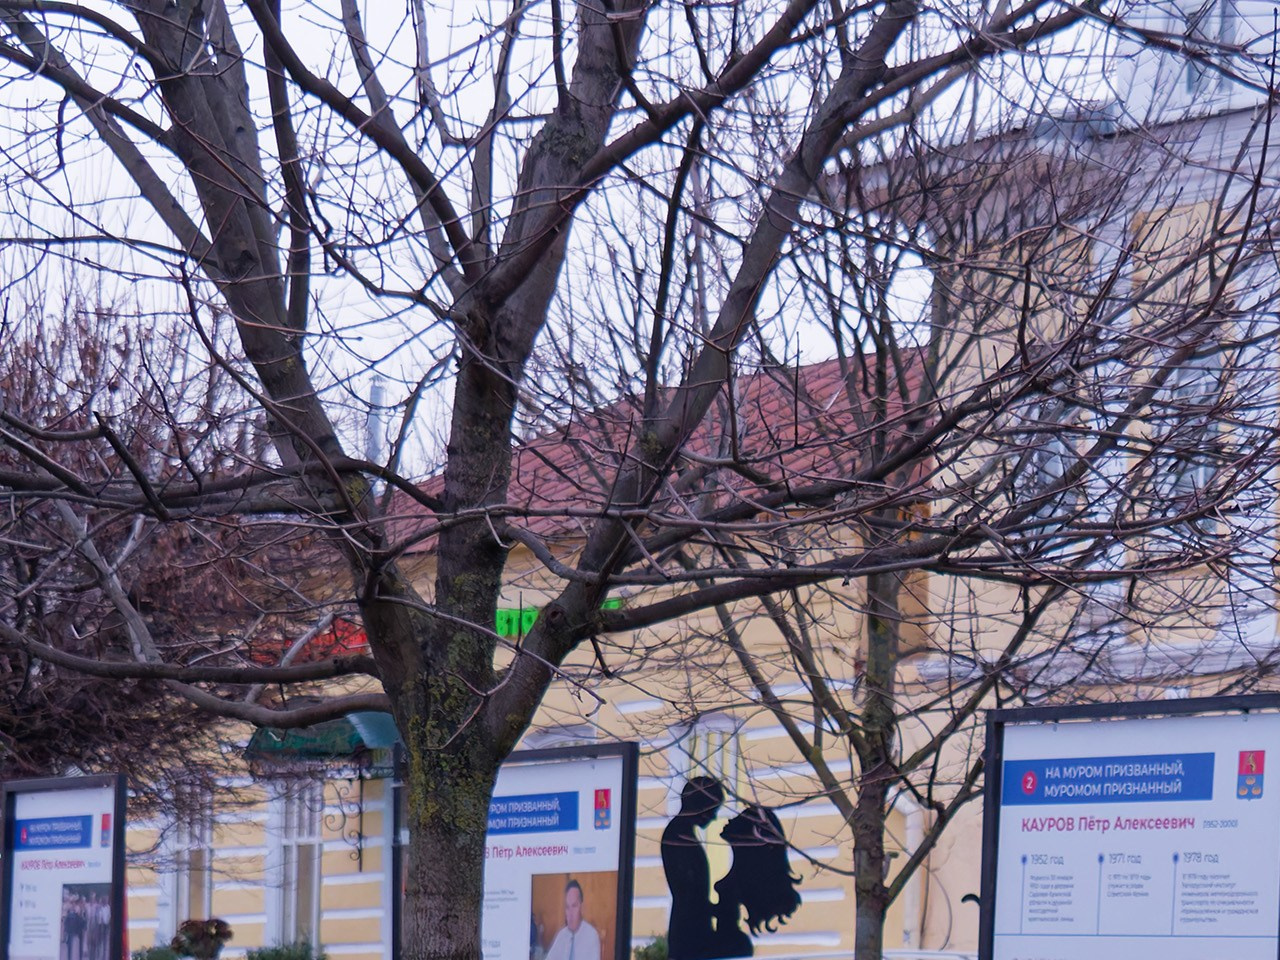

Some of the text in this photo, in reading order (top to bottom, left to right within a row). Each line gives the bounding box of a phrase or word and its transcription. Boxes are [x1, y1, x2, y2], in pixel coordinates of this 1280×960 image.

[1046, 760, 1184, 779] НА МУРОМ ПРИЗВАННЫЙ,
[1026, 777, 1033, 789] 2
[1044, 779, 1182, 798] МУРОМОМ ПРИЗНАННЫЙ
[508, 813, 559, 828] ПРИЗНАННЫЙ
[1022, 818, 1075, 832] КАУРОВ
[1078, 816, 1110, 834] Пётр
[1114, 816, 1196, 831] Алексеевич
